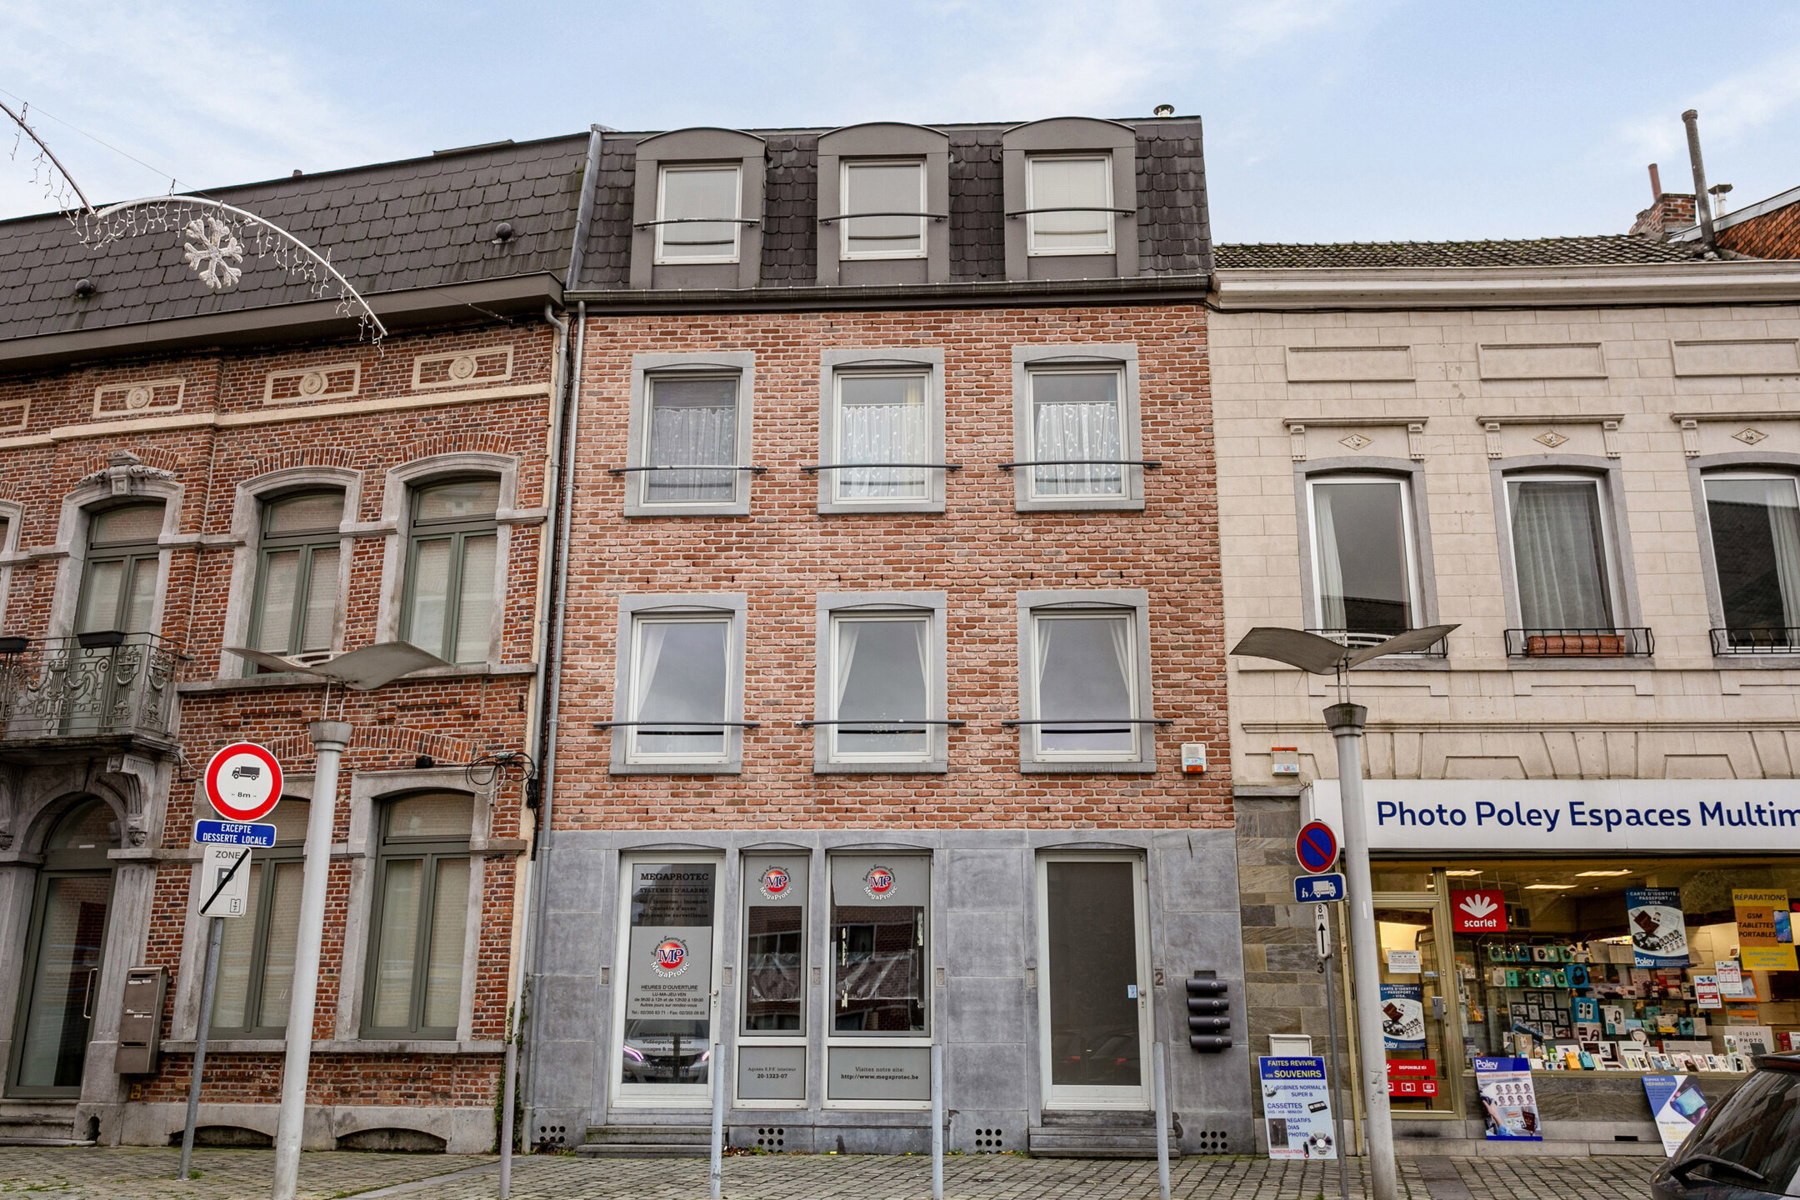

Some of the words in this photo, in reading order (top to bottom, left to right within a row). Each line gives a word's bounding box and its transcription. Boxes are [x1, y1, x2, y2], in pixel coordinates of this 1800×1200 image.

[1377, 801, 1466, 826] Photo
[1475, 801, 1560, 832] Poley
[1569, 801, 1691, 832] Espaces
[221, 823, 252, 834] EXCEPTE
[202, 832, 238, 843] DESSERTE
[241, 835, 267, 845] LOCALE
[215, 850, 241, 860] ZONE
[640, 873, 709, 881] MEGAPROTEC
[1464, 919, 1497, 928] scarlet
[650, 961, 690, 978] MegaProtec
[1317, 962, 1324, 974] 3
[1475, 1059, 1498, 1070] Poley
[1274, 1070, 1322, 1078] SOUVENIRS
